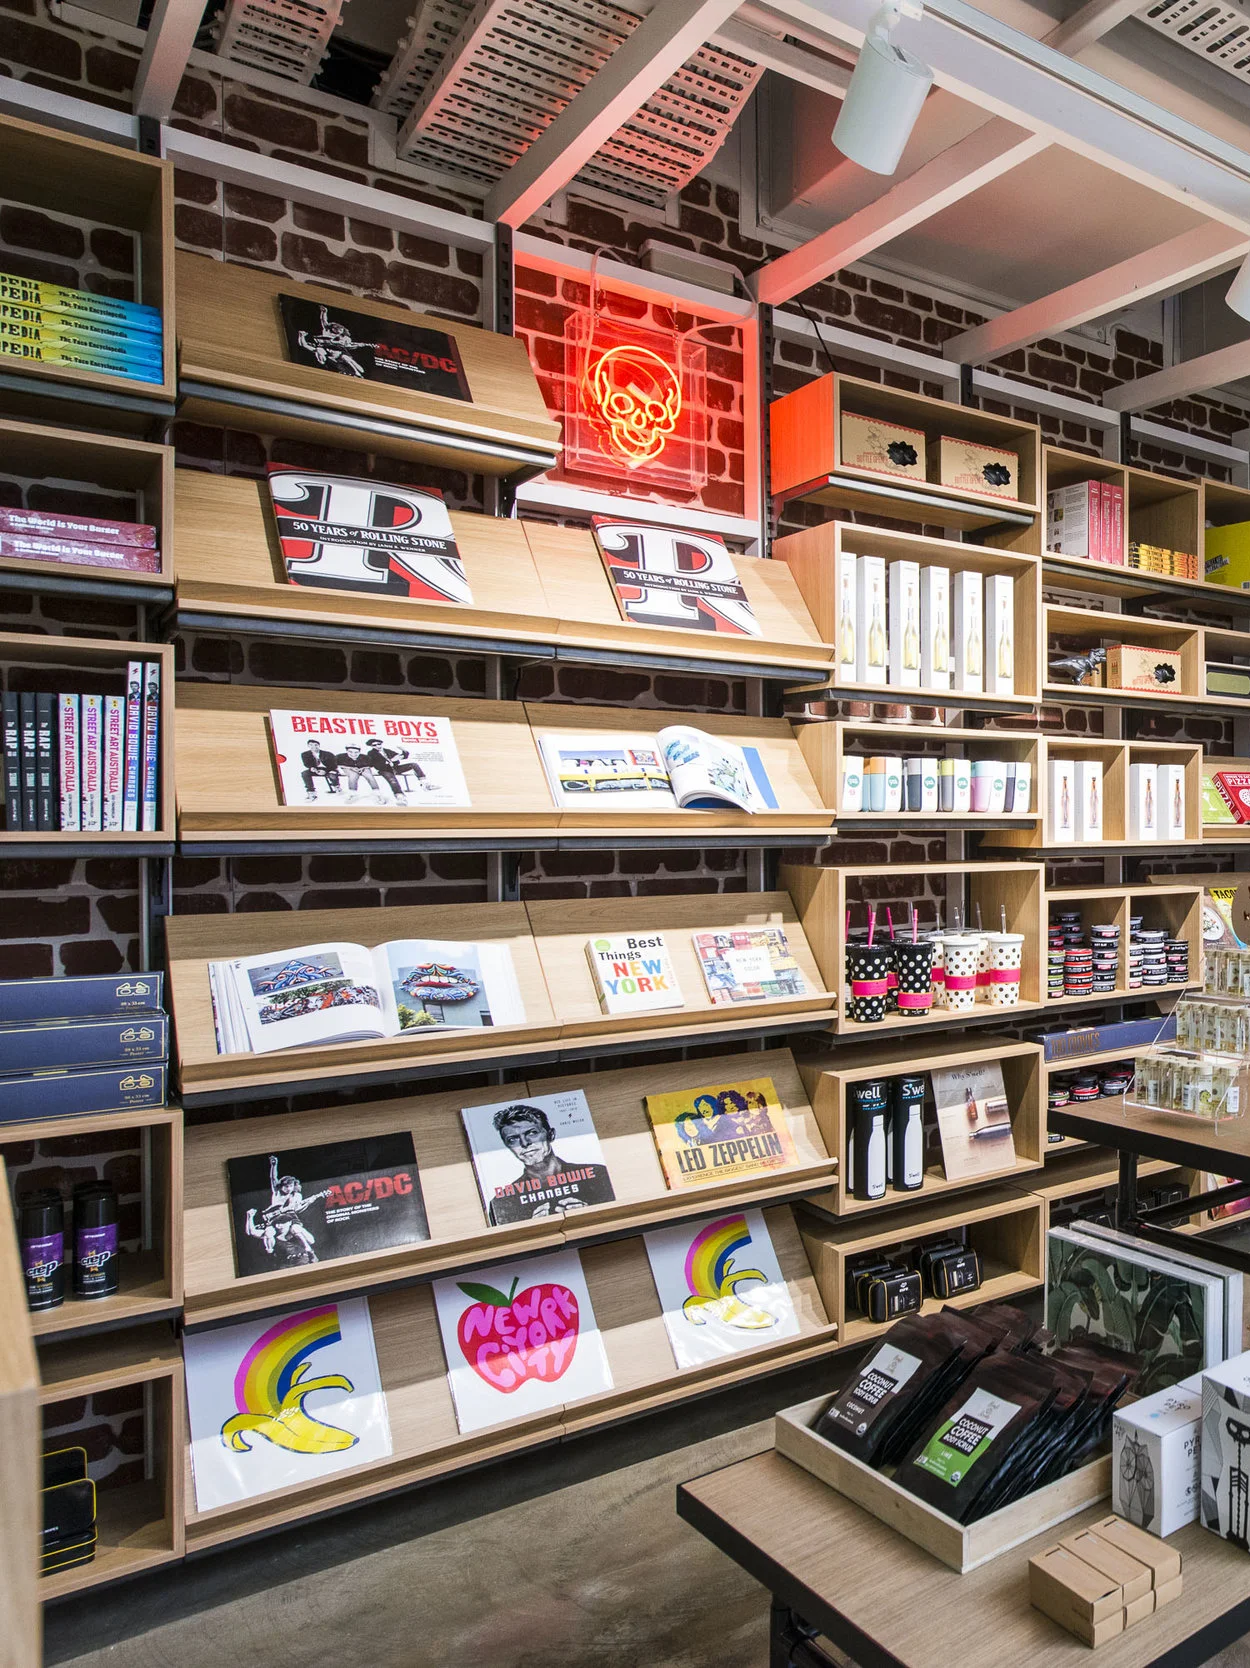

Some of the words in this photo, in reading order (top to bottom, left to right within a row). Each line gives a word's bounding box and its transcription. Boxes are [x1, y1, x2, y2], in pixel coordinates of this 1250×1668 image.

[73, 302, 88, 311] Taco
[89, 306, 127, 320] Encyclopedia
[61, 319, 72, 327] The
[74, 321, 88, 331] Taco
[90, 325, 128, 338] Encyclopedia
[73, 338, 87, 347] Taco
[89, 341, 126, 354] Encyclopedia
[61, 354, 72, 362] The
[74, 356, 88, 366] Taco
[90, 360, 128, 373] Encyclopedia
[375, 343, 458, 374] AC/DC
[9, 514, 27, 524] The
[28, 516, 57, 528] World
[67, 521, 88, 532] Your
[89, 524, 120, 535] Burger
[292, 521, 308, 532] 50
[310, 522, 348, 538] YEARS
[360, 529, 409, 545] ROLLING
[411, 536, 447, 550] STONE
[319, 535, 368, 546] INTRODUCTION
[14, 540, 32, 549] The
[33, 541, 61, 552] World
[72, 545, 93, 556] Your
[94, 548, 124, 560] Burger
[623, 570, 636, 580] 50
[636, 571, 665, 584] YEARS
[673, 577, 711, 591] ROLLING
[711, 582, 739, 595] STONE
[64, 707, 74, 734] STREET
[87, 707, 97, 735] STREET
[109, 709, 119, 736] STREET
[129, 704, 139, 731] DAVID
[147, 705, 158, 731] DAVID
[291, 715, 377, 735] BEASTIE
[384, 719, 438, 737] BOYS
[5, 730, 17, 749] RAP
[23, 730, 35, 749] RAP
[38, 730, 50, 749] RAP
[64, 735, 74, 751] ART
[87, 735, 97, 751] ART
[109, 736, 119, 752] ART
[127, 733, 139, 761] BOWIE
[146, 734, 157, 761] BOWIE
[64, 751, 74, 793] AUSTRALIA
[87, 750, 97, 793] AUSTRALIA
[109, 752, 119, 794] AUSTRALIA
[1215, 780, 1232, 808] PIZZA
[1214, 890, 1237, 899] TACO
[627, 936, 663, 949] Best
[598, 951, 642, 961] Things
[612, 959, 662, 978] NEW
[605, 977, 669, 995] YORK
[951, 1072, 965, 1081] Why
[675, 1147, 707, 1174] LED
[708, 1132, 784, 1168] ZEPPELIN
[325, 1173, 414, 1208] AC/DC
[494, 1177, 542, 1199] DAVID
[546, 1166, 596, 1187] BOWIE
[519, 1183, 580, 1205] CHANGES
[326, 1211, 350, 1220] ORIGINAL
[351, 1206, 380, 1215] MONSTERS
[26, 1260, 58, 1277] crep
[81, 1251, 111, 1266] crep
[463, 1288, 543, 1343] NEW
[503, 1286, 579, 1358] YORK
[859, 1378, 888, 1399] COFFEE
[867, 1371, 894, 1390] COCONUT
[853, 1387, 865, 1398] BODY
[863, 1392, 880, 1405] SCRUB
[846, 1401, 865, 1415] COCONUT
[959, 1417, 990, 1435] COCONUT
[943, 1433, 957, 1445] BODY
[955, 1439, 974, 1453] SCRUB
[951, 1426, 982, 1447] COFFEE
